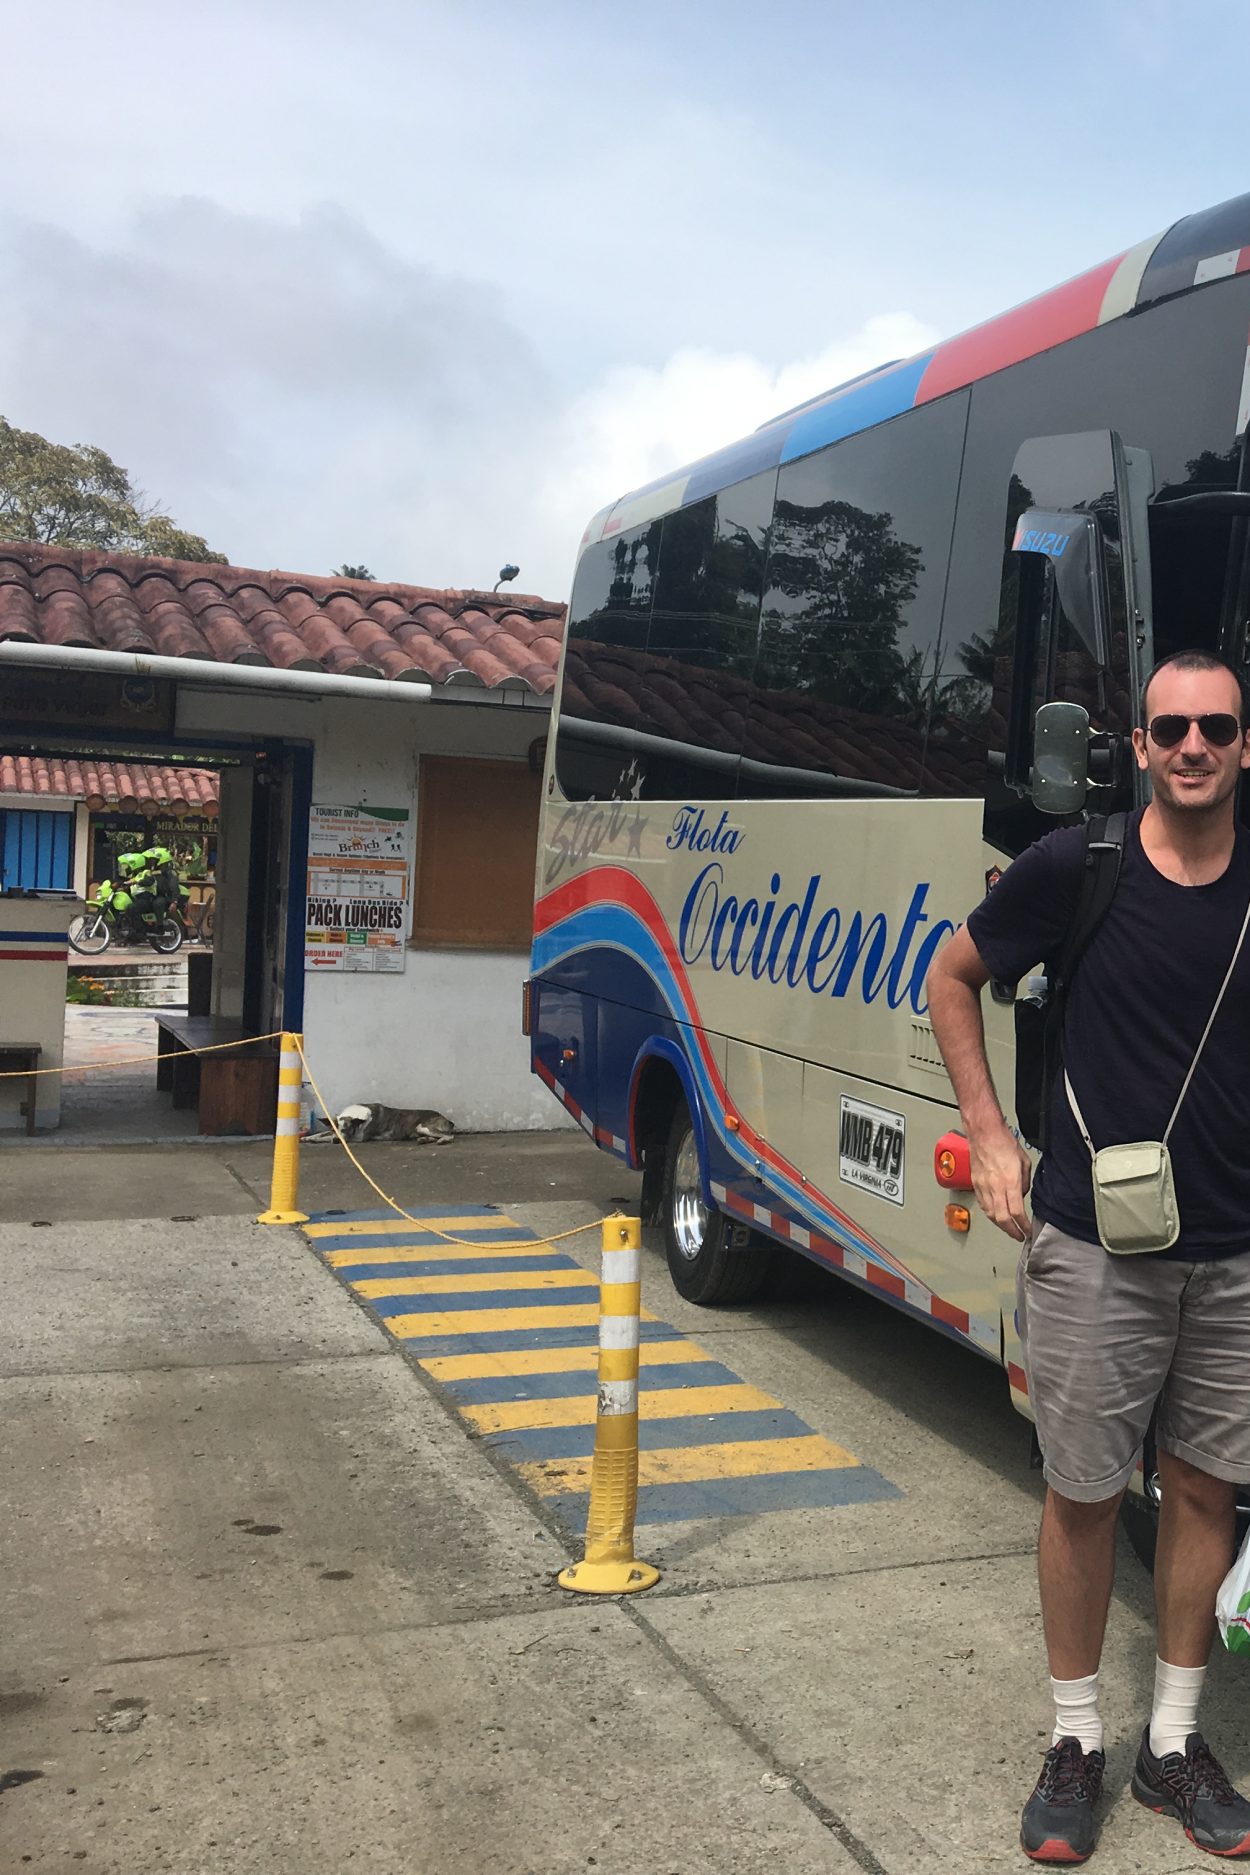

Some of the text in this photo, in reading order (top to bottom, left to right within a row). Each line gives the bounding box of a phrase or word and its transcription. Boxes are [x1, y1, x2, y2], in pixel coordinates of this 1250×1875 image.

[1018, 530, 1071, 557] ISUZU
[315, 807, 359, 818] TOURIST INFO
[156, 821, 218, 832] MIRADOR DEL
[666, 806, 747, 854] Flota
[339, 840, 380, 852] Brunch
[307, 903, 402, 929] PACK LUNCHES
[679, 863, 967, 1015] Occidenta
[872, 1123, 904, 1180] 479
[851, 1169, 882, 1189] LA VIRGINIA
